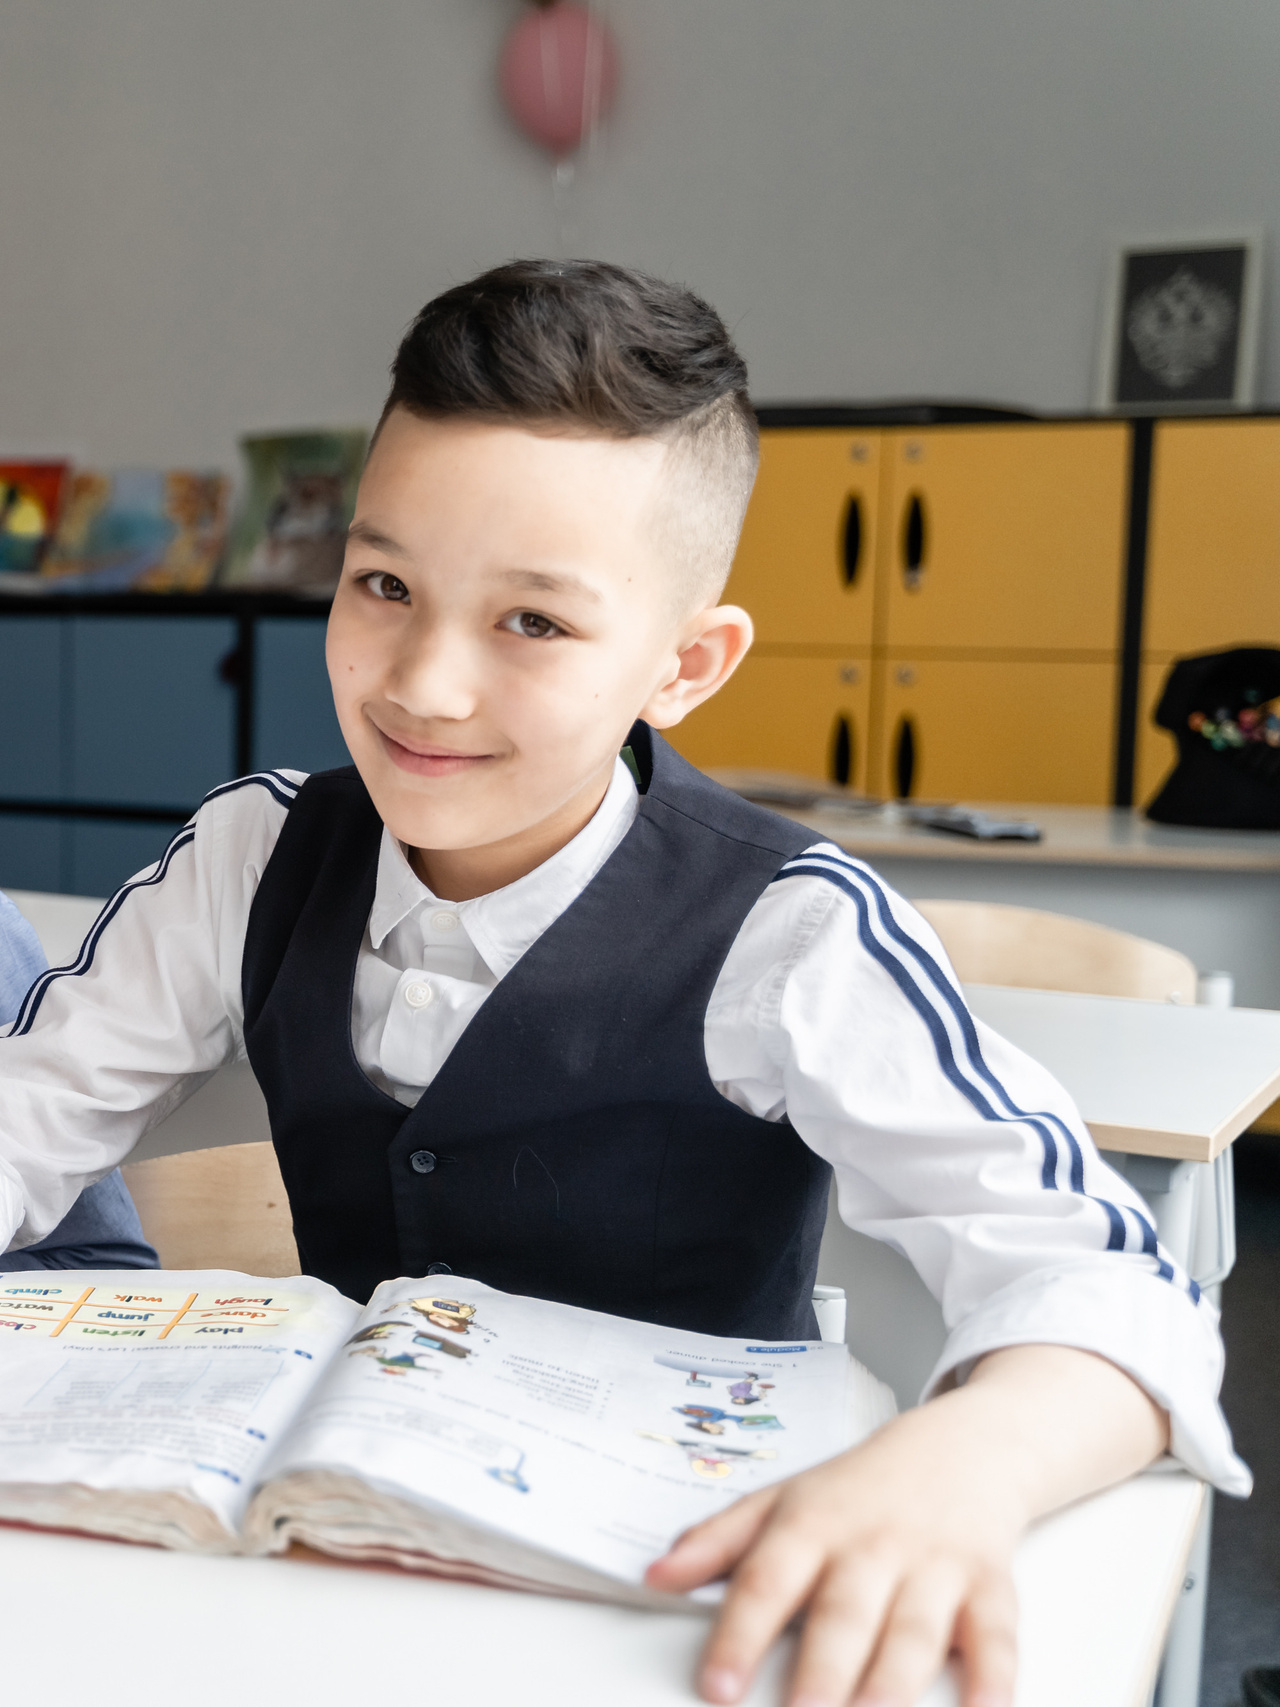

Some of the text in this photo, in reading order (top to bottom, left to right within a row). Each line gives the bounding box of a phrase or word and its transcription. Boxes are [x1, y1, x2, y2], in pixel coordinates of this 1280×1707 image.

[4, 1287, 274, 1306] laugh walk climb
[97, 1311, 155, 1322] jump
[200, 1311, 267, 1320] dance
[82, 1328, 147, 1338] listen
[194, 1326, 244, 1335] play
[711, 1358, 756, 1366] cooked
[501, 1359, 598, 1390] play basketball
[508, 1354, 600, 1384] listen to music
[512, 1369, 534, 1380] dog
